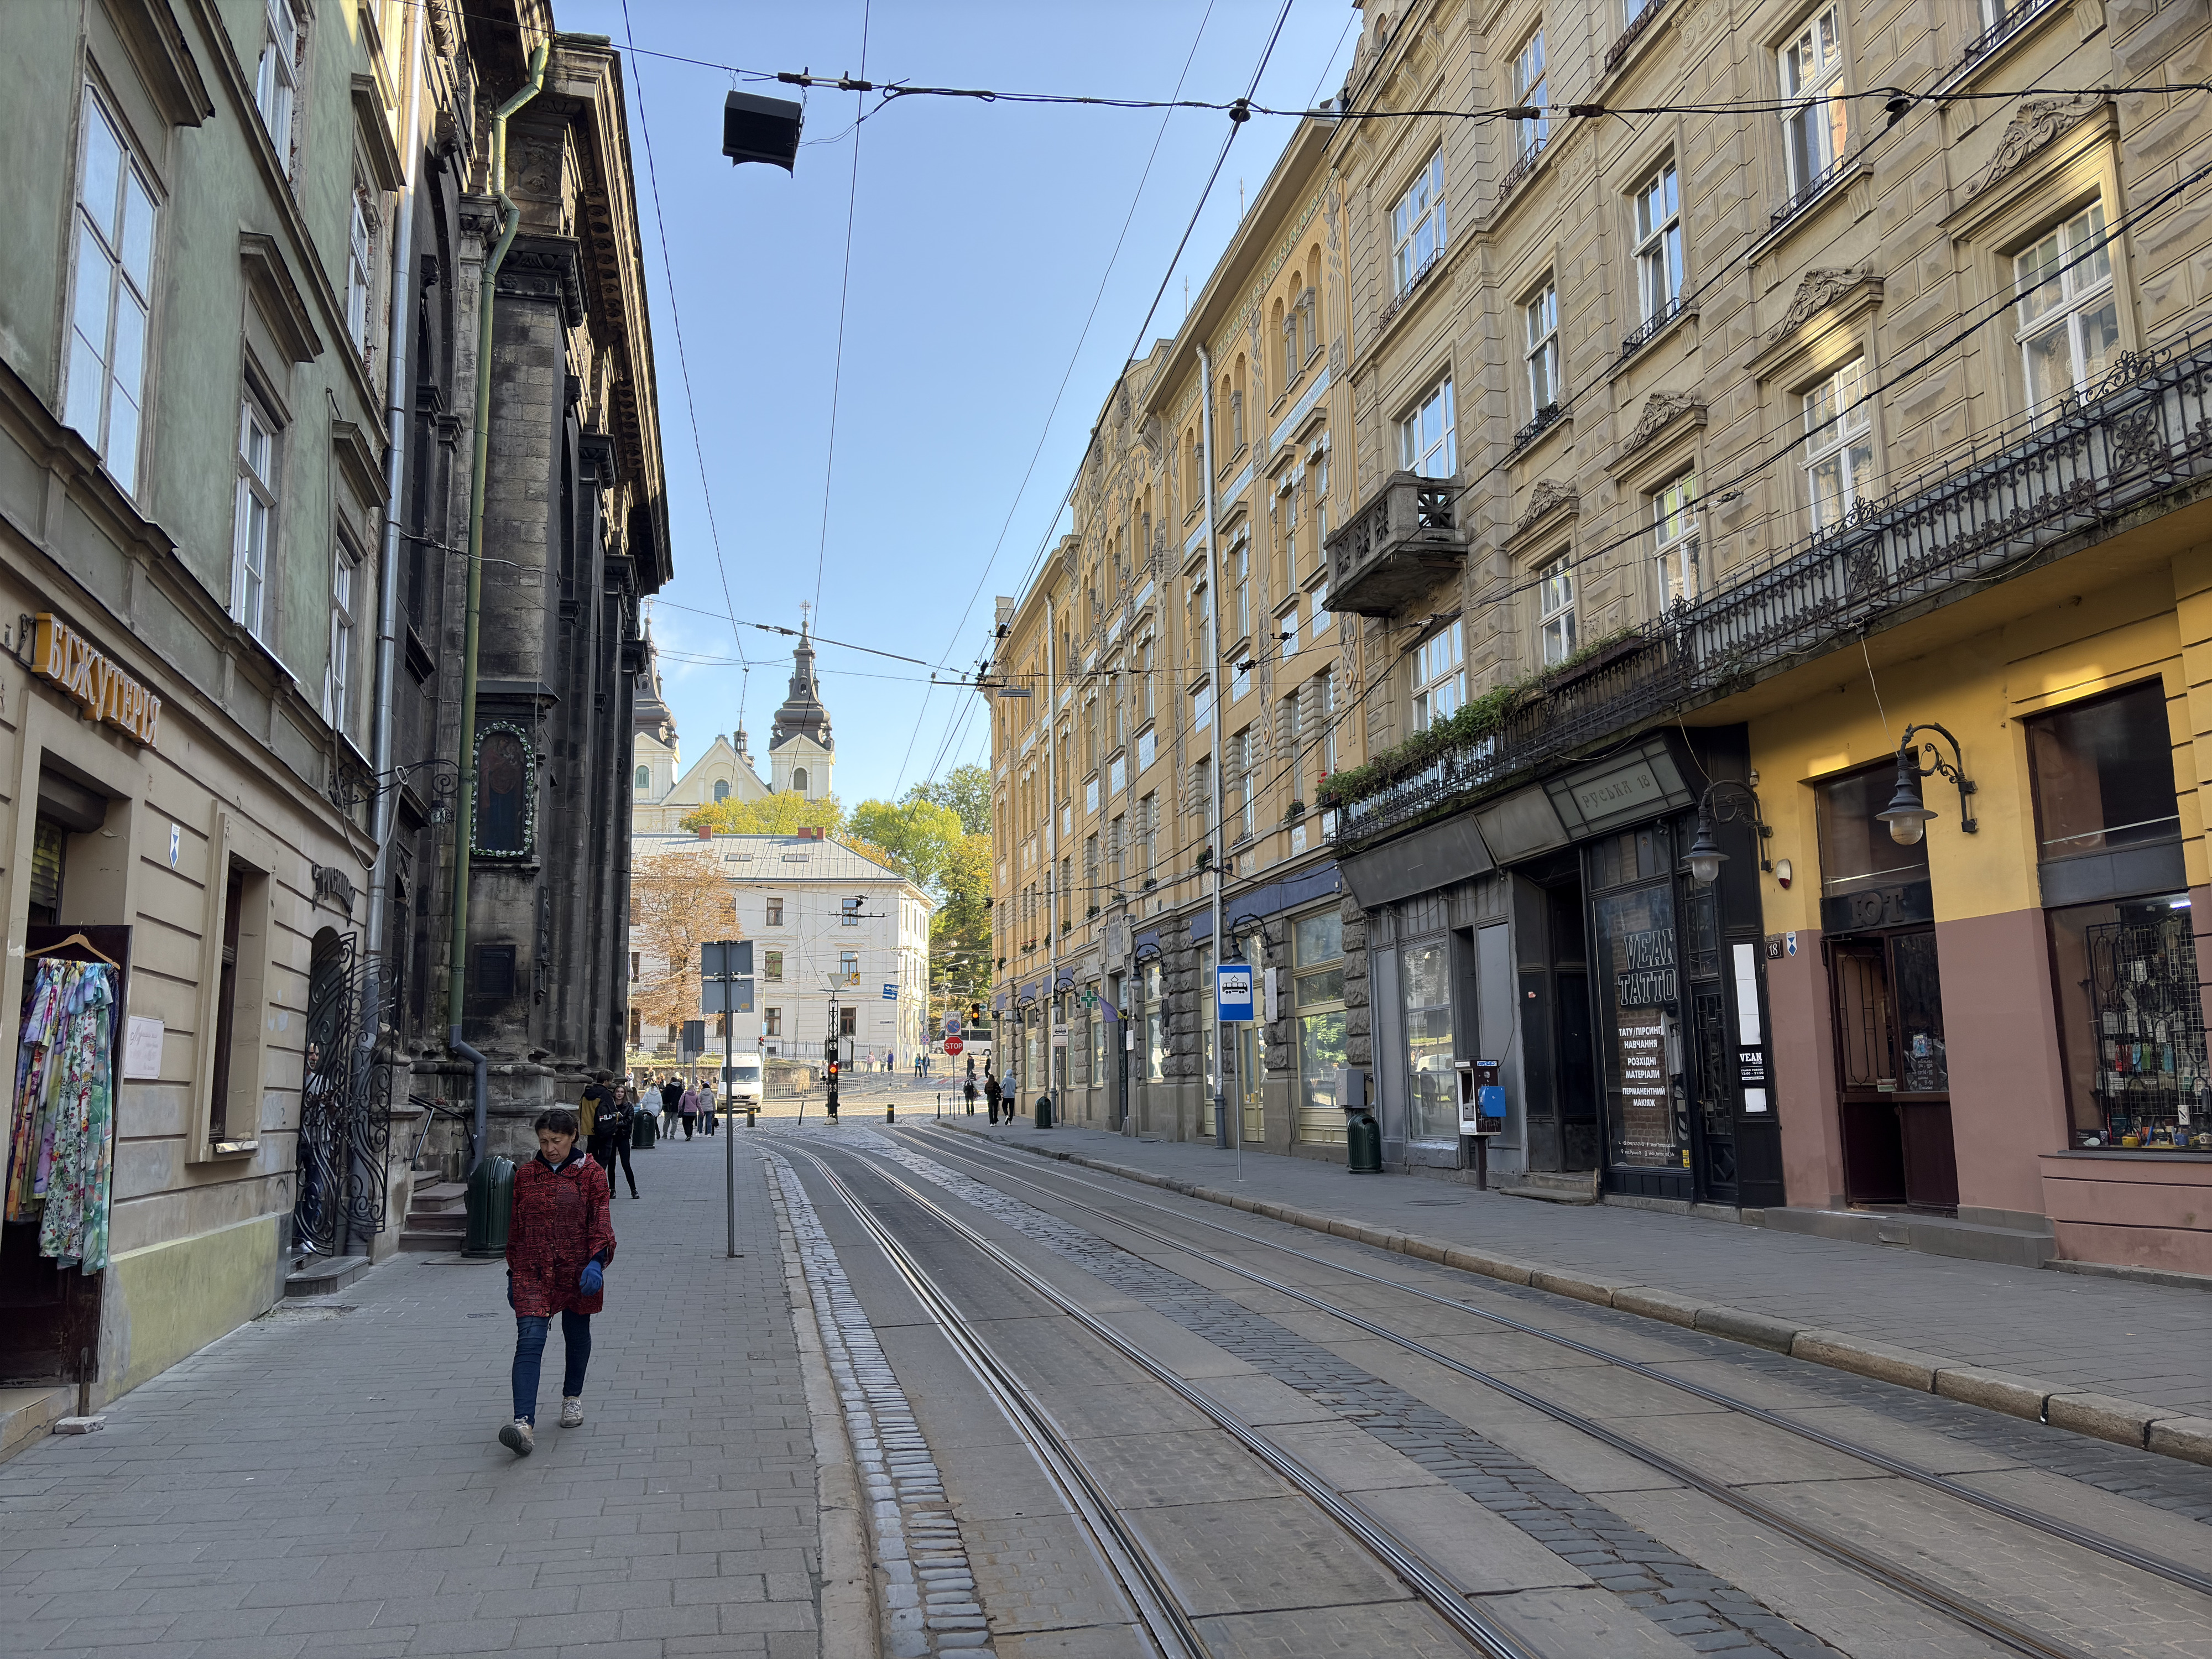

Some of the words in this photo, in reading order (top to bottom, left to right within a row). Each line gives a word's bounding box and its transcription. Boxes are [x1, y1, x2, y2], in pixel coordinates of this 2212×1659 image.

[48, 613, 161, 750] БІЖУТЕРІЯ
[1582, 780, 1632, 808] РУСЬКА
[1637, 775, 1651, 789] 18
[1768, 943, 1778, 956] 18
[1618, 969, 1678, 1005] TATTO
[1624, 1039, 1657, 1049] НАВЧАННЯ
[1627, 1057, 1656, 1067] РОЗХІДНІ
[1739, 1052, 1762, 1062] VEAN
[1626, 1070, 1660, 1079] МАТЕРІАЛИ
[1623, 1086, 1665, 1095] ПЕРМАНЕНТНИЙ
